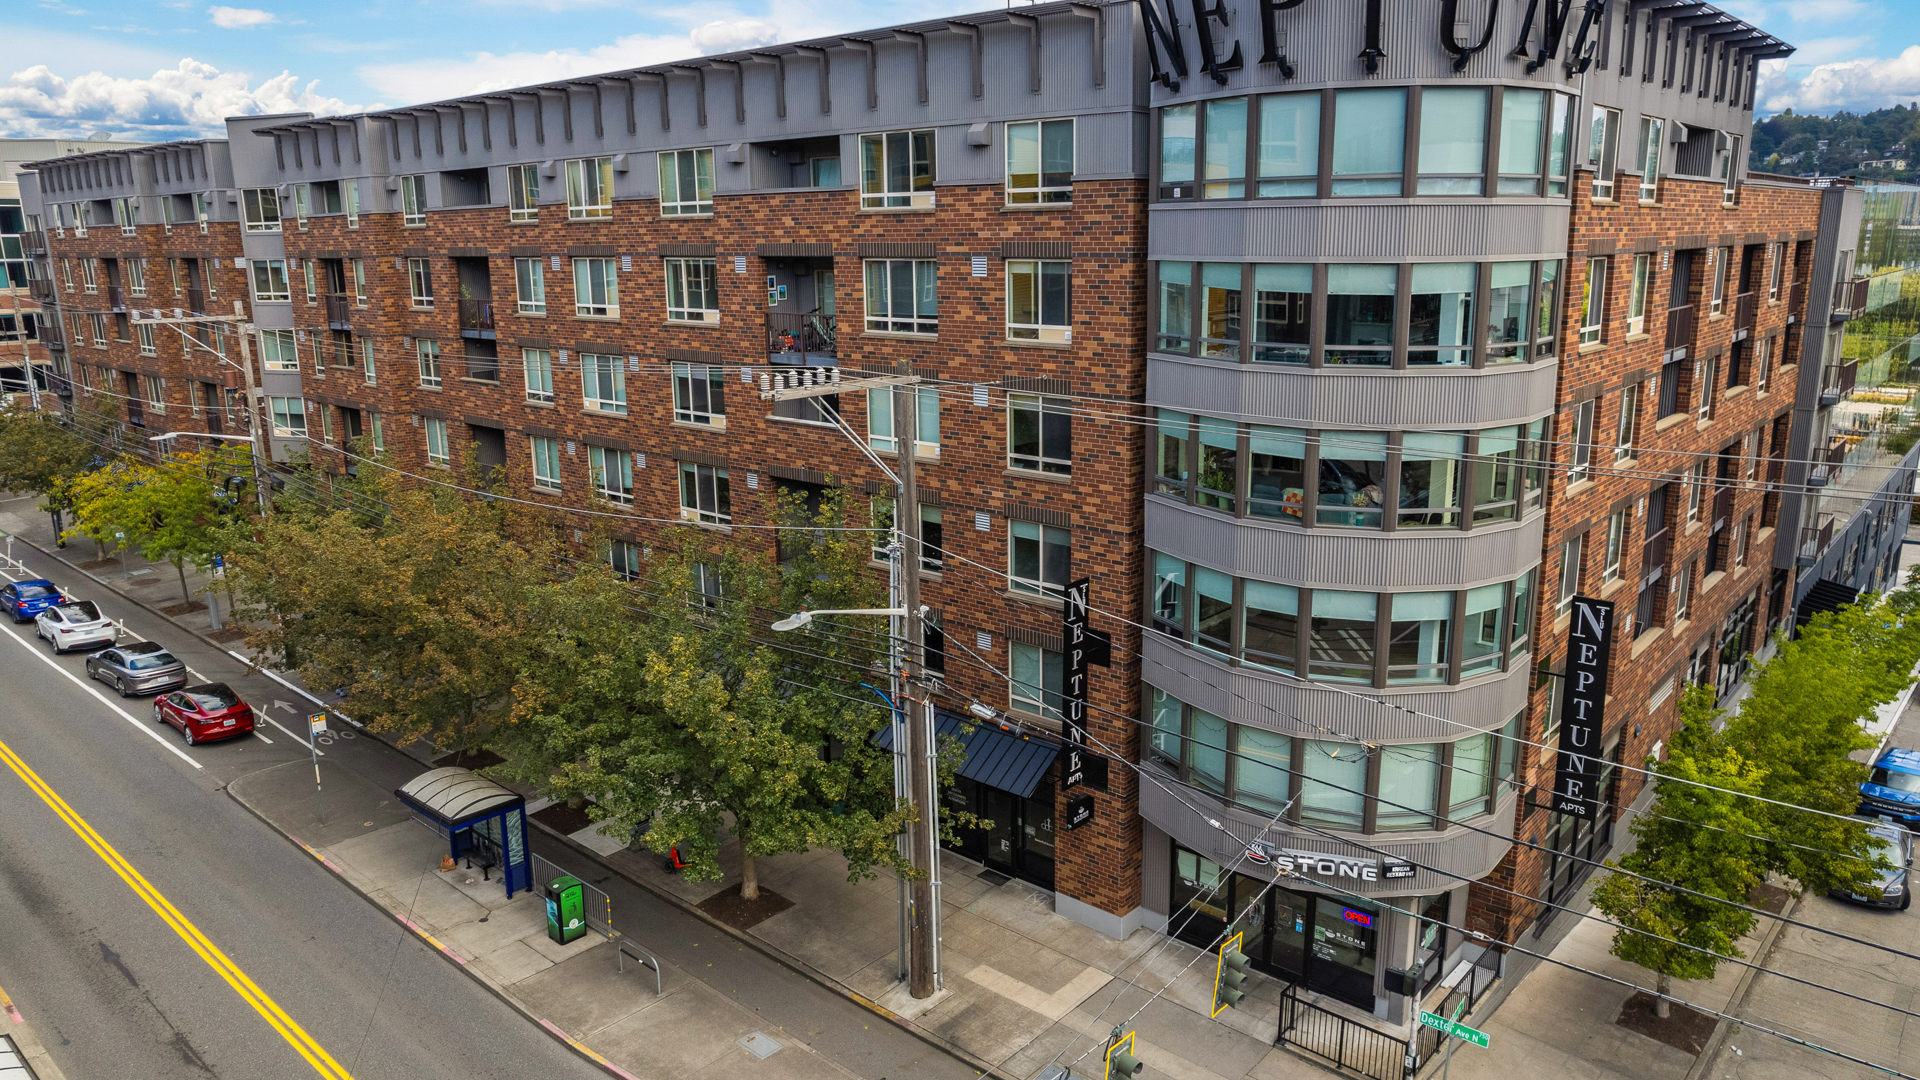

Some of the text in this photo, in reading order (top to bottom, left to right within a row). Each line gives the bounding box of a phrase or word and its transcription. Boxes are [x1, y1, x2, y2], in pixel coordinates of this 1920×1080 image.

[1067, 583, 1088, 773] NEPTUNE
[1565, 602, 1610, 801] NEPTUNE
[1559, 801, 1586, 815] APTS
[1277, 856, 1378, 882] STONE
[1344, 910, 1370, 925] OPEN
[1336, 932, 1366, 946] STONE
[1421, 1012, 1454, 1032] Dexter
[1455, 1028, 1470, 1039] Ave
[1471, 1034, 1479, 1042] N
